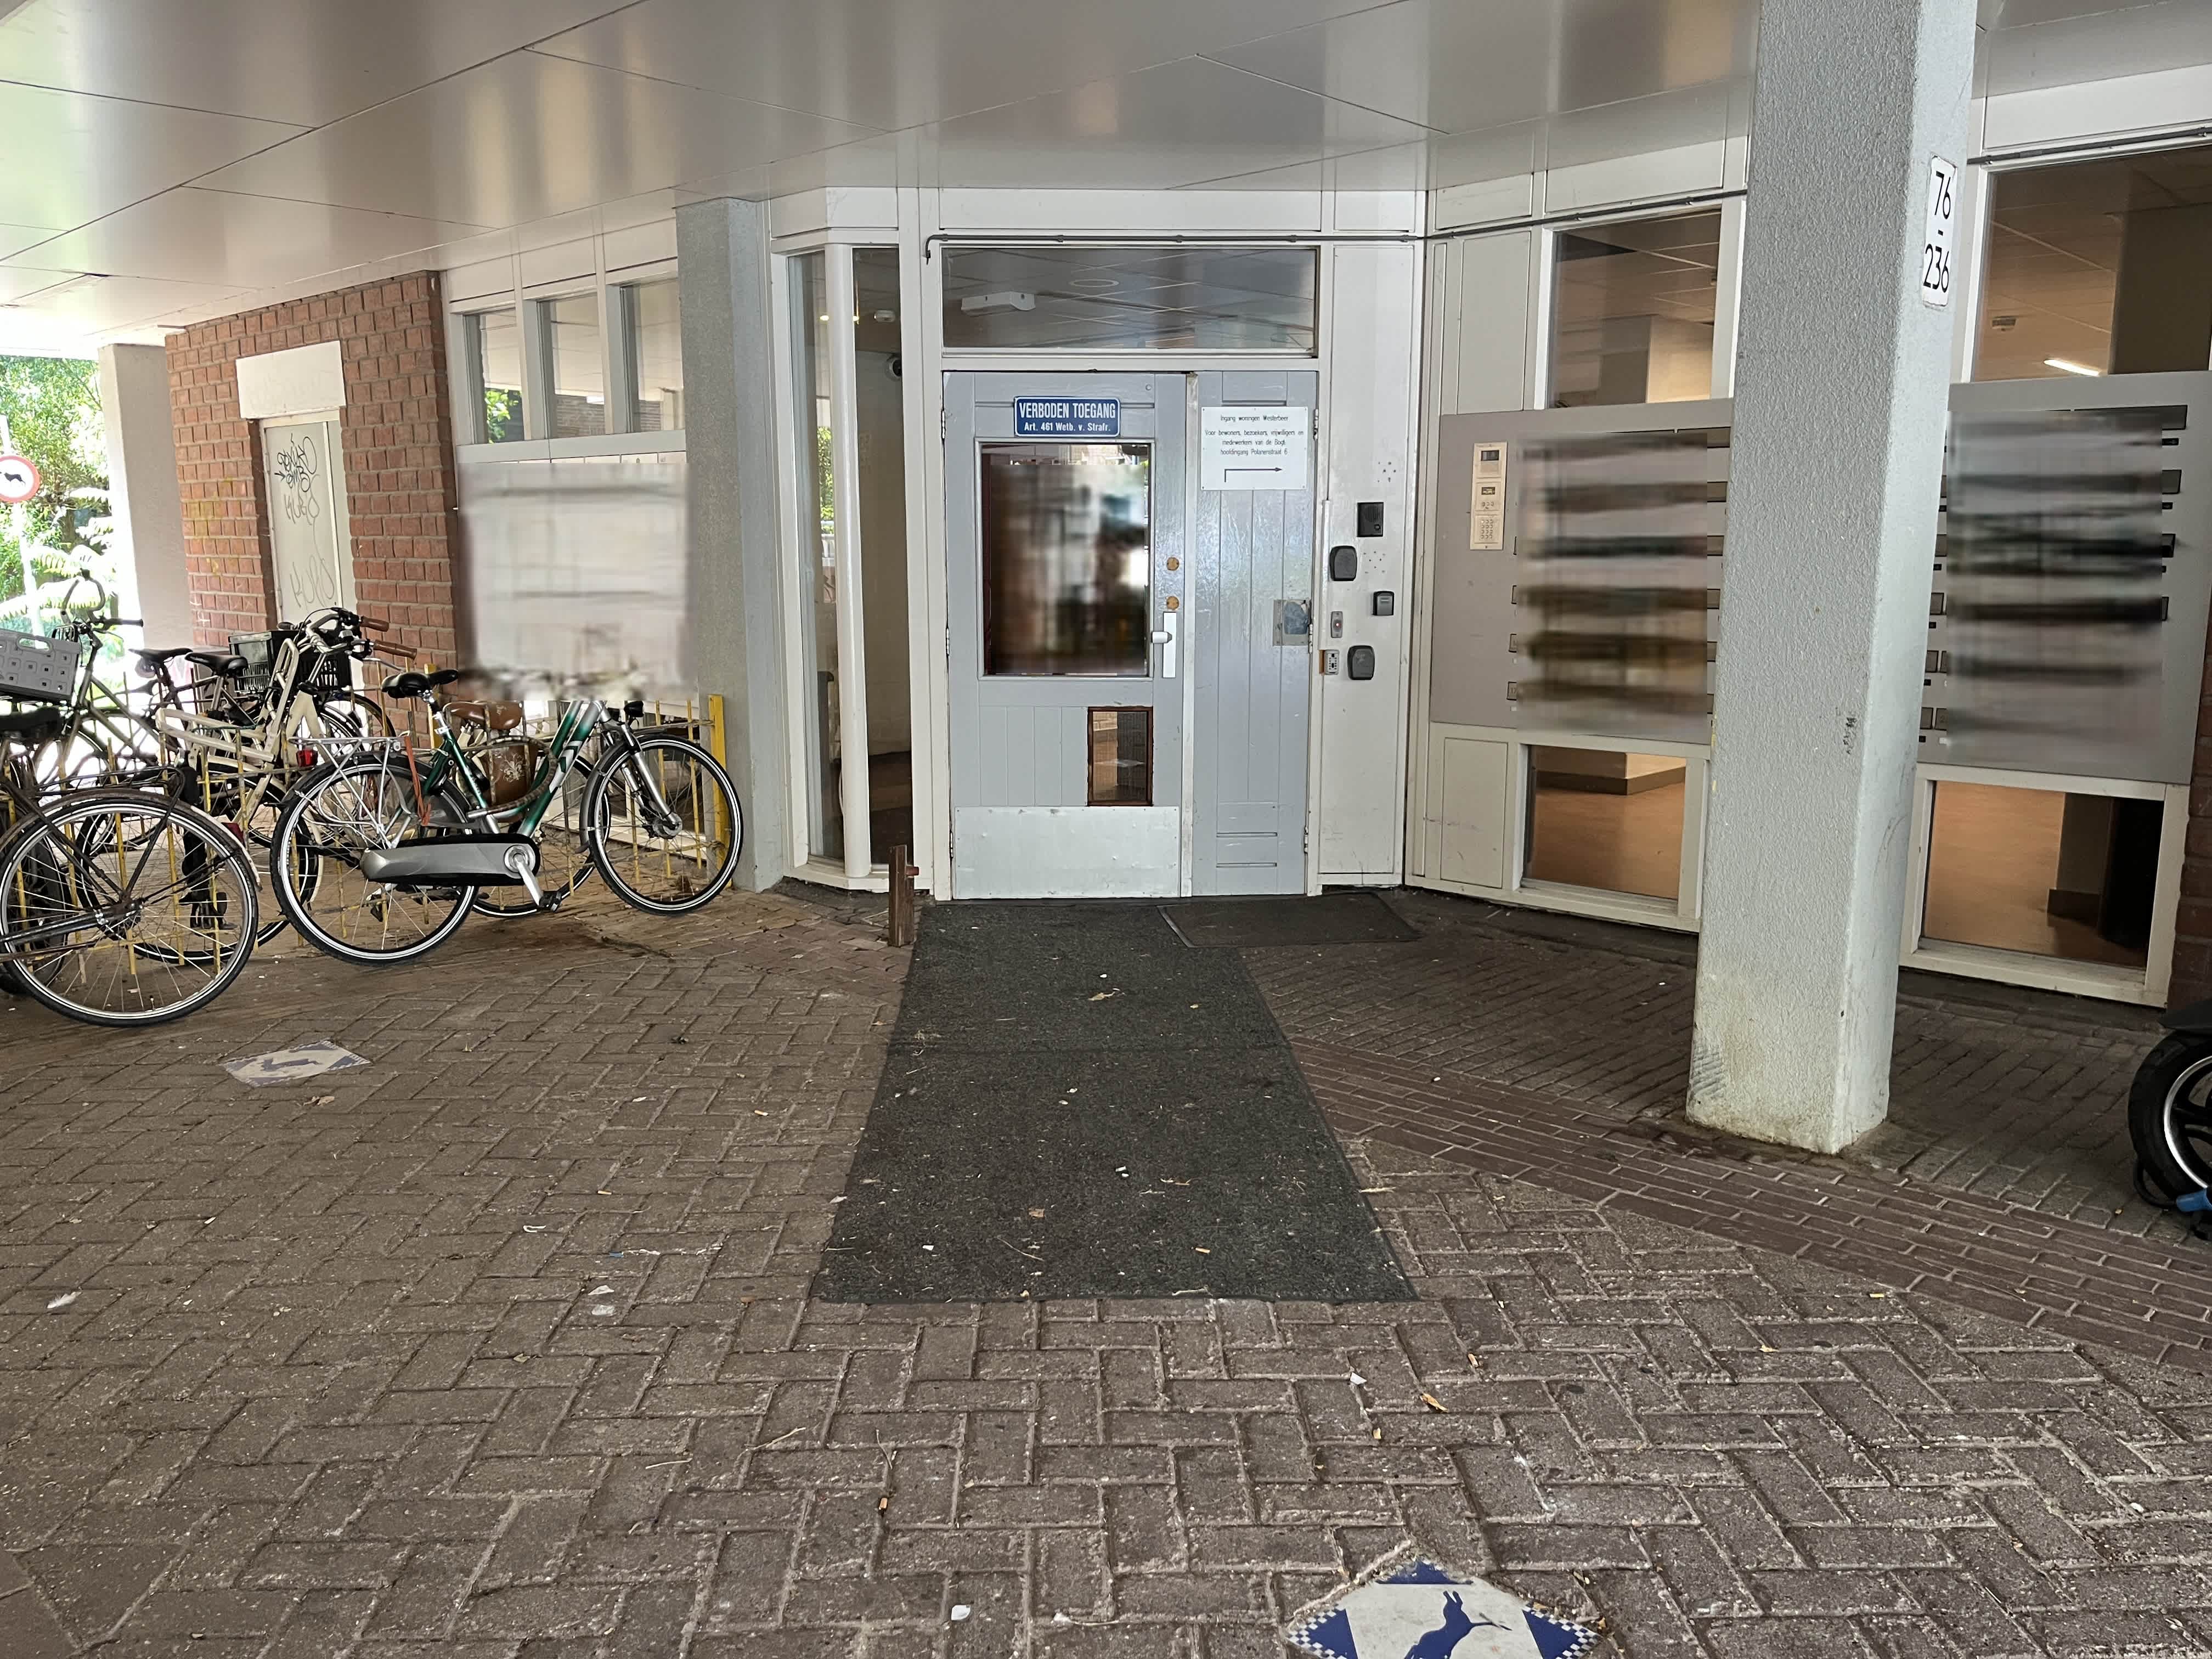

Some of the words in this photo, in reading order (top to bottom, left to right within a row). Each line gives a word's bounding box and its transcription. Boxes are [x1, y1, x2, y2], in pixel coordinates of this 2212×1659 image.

[1934, 171, 1951, 220] 76
[1922, 243, 1950, 294] 236
[1019, 402, 1069, 418] VERBODEN
[1072, 403, 1116, 419] TOEGANG
[1024, 422, 1038, 431] Art.
[1041, 422, 1053, 431] 461
[1056, 422, 1076, 431] Wetb.
[1087, 422, 1111, 431] Strafr.
